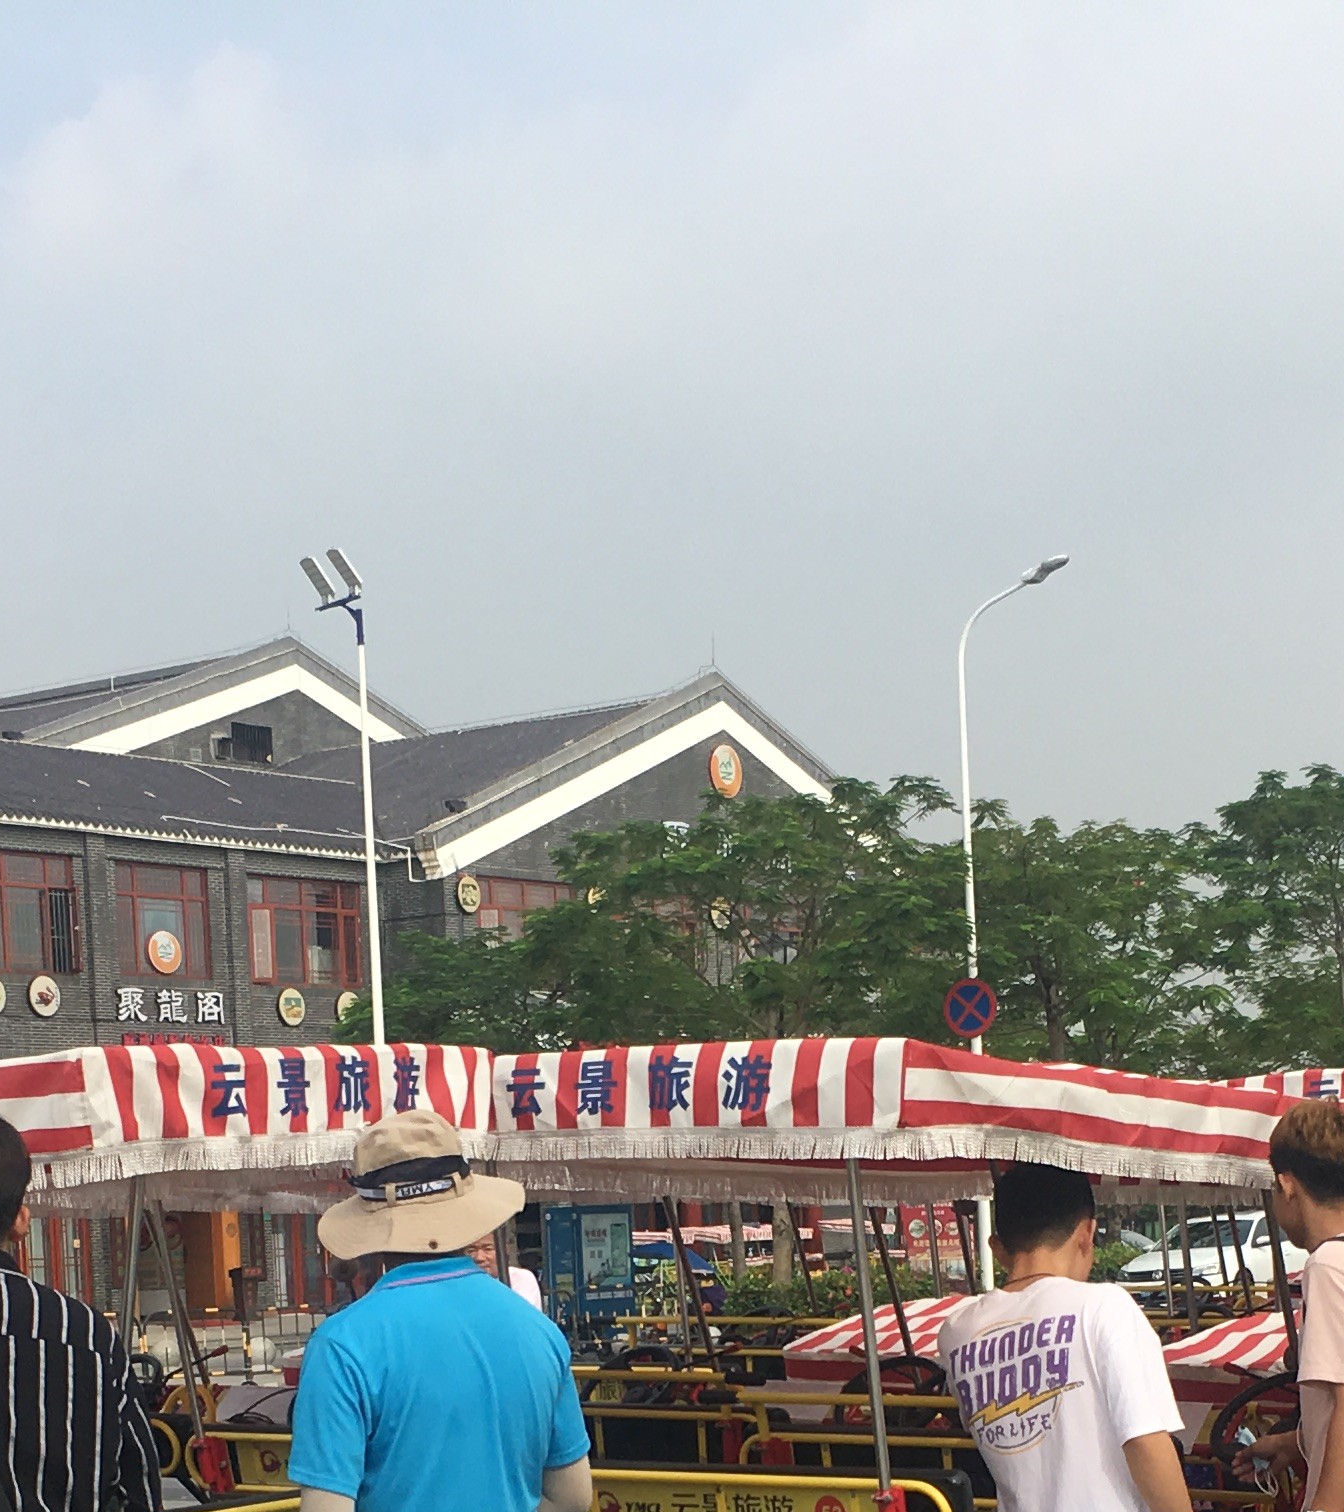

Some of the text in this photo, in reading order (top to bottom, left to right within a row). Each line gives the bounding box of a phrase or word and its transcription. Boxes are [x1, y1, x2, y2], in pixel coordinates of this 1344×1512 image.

[211, 1055, 421, 1119] 云景旅游
[506, 1054, 773, 1119] 云景旅游
[949, 1314, 1076, 1380] THUNDER
[956, 1347, 1070, 1420] BUDDY
[976, 1412, 1053, 1445] FOR LIFE
